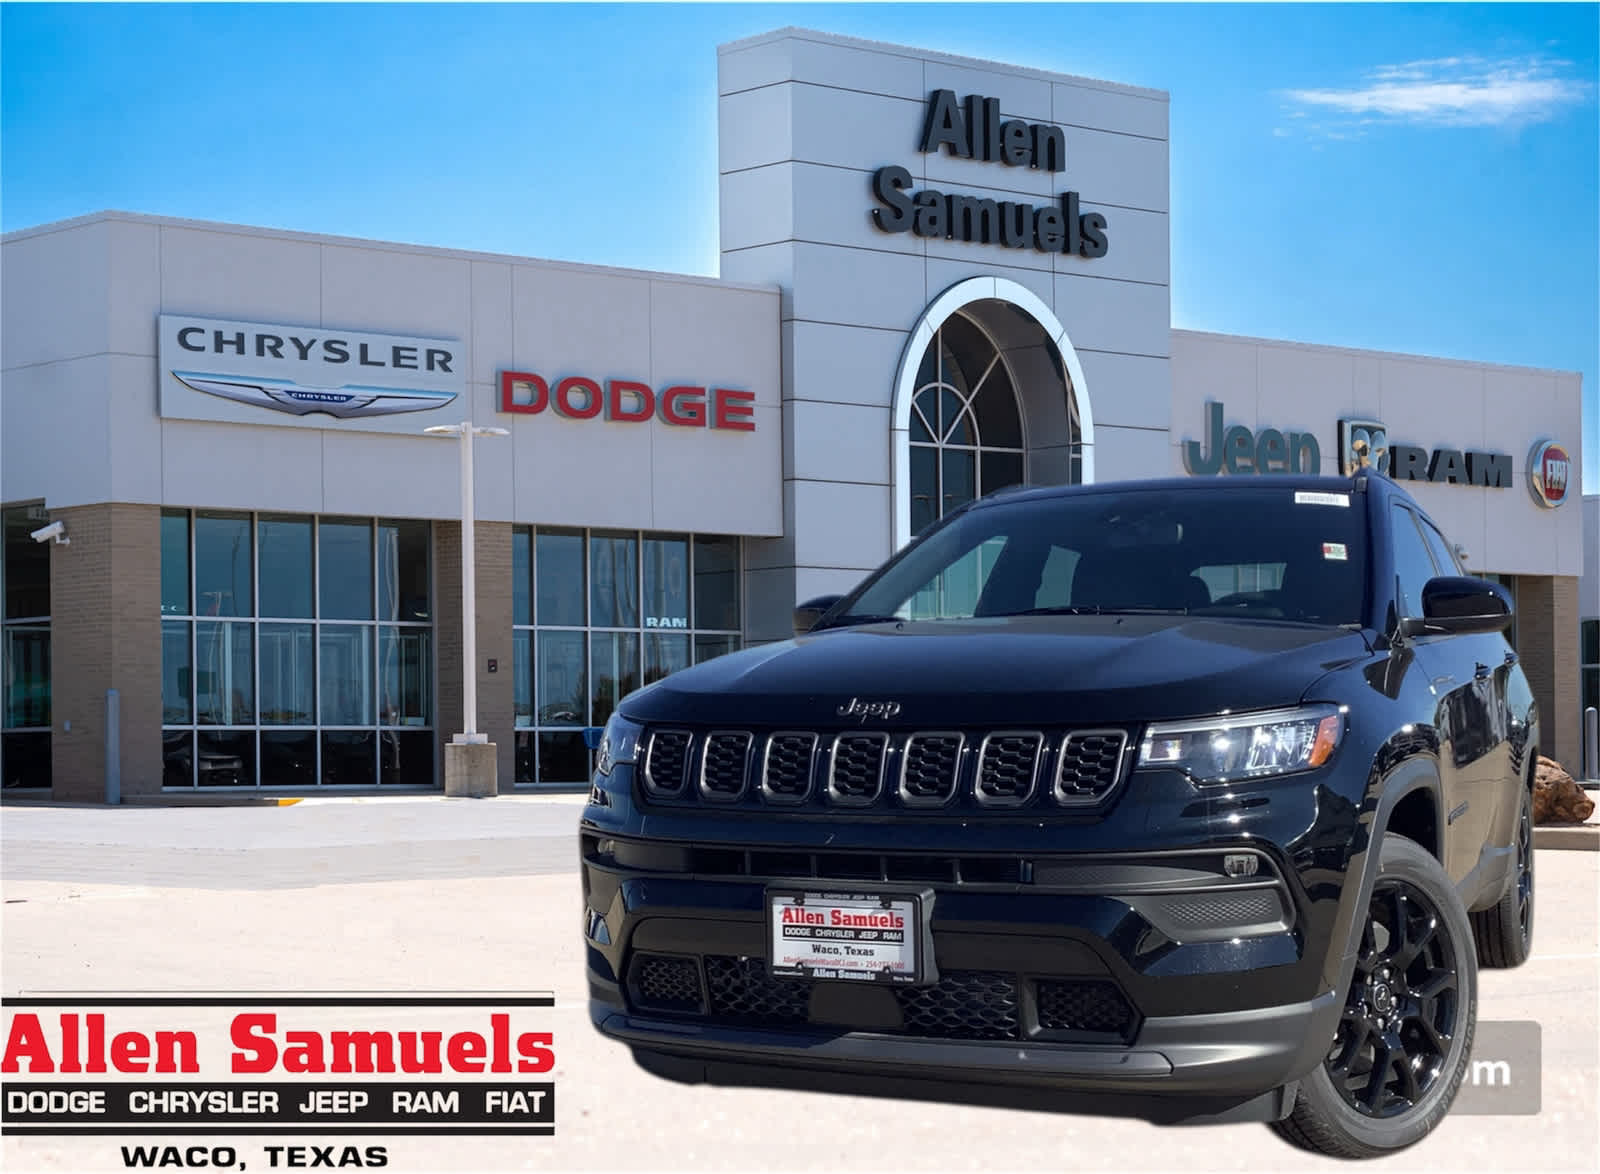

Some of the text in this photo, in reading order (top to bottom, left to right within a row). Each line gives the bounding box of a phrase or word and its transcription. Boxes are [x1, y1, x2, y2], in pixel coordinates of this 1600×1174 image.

[918, 89, 1066, 172] Allen
[872, 165, 1108, 258] Samuels
[177, 326, 454, 373] CHRYSLER
[291, 392, 347, 401] CHRYSLER
[496, 370, 756, 432] DODGE
[1389, 444, 1513, 488] RAM
[1546, 459, 1568, 489] FIAT
[646, 616, 687, 628] RAM
[836, 697, 901, 722] Jeep
[782, 907, 905, 928] Allen Samuels
[785, 927, 902, 941] DODGE CHRYSLER JEEP RAM
[812, 944, 875, 957] Waco, Texas
[812, 968, 837, 978] Allen
[838, 970, 876, 981] Samuels
